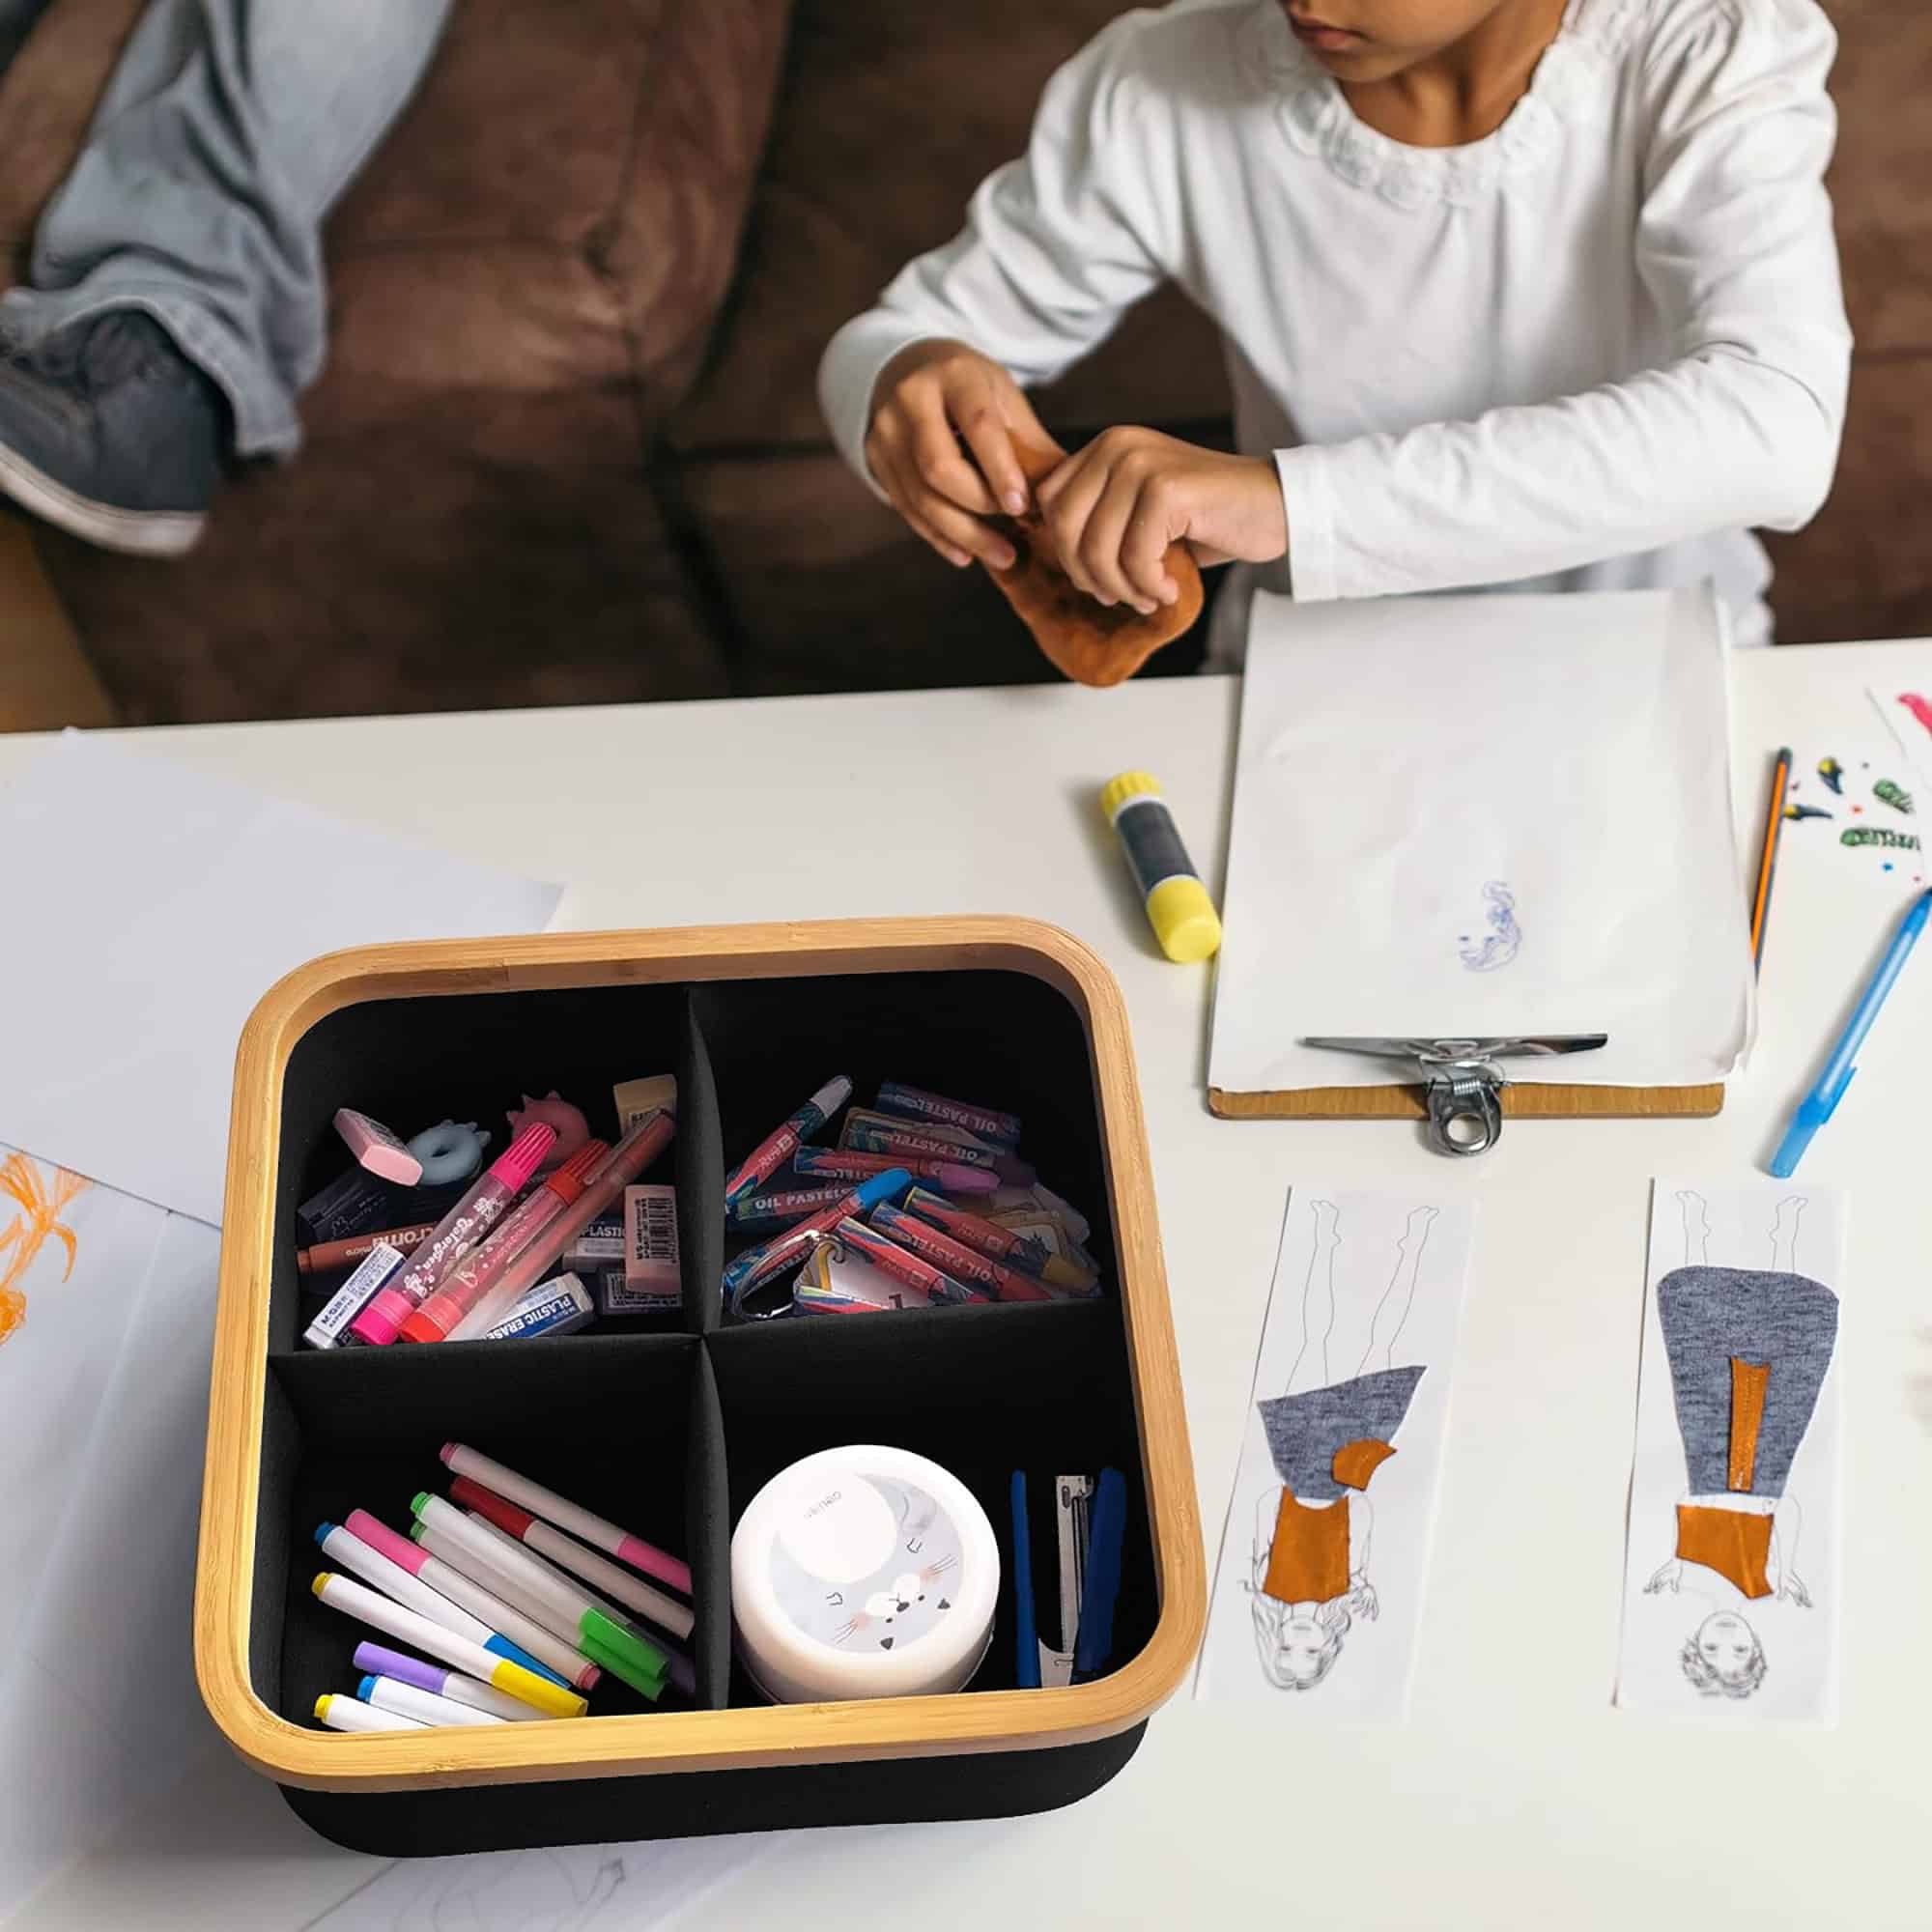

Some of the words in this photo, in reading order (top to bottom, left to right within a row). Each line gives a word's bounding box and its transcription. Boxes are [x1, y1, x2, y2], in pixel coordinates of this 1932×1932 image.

[973, 1117, 997, 1132] OIL
[952, 1147, 978, 1160] OIL
[754, 1197, 781, 1209] OIL
[967, 1262, 992, 1282] OIL
[524, 1295, 572, 1325] PLASTIC
